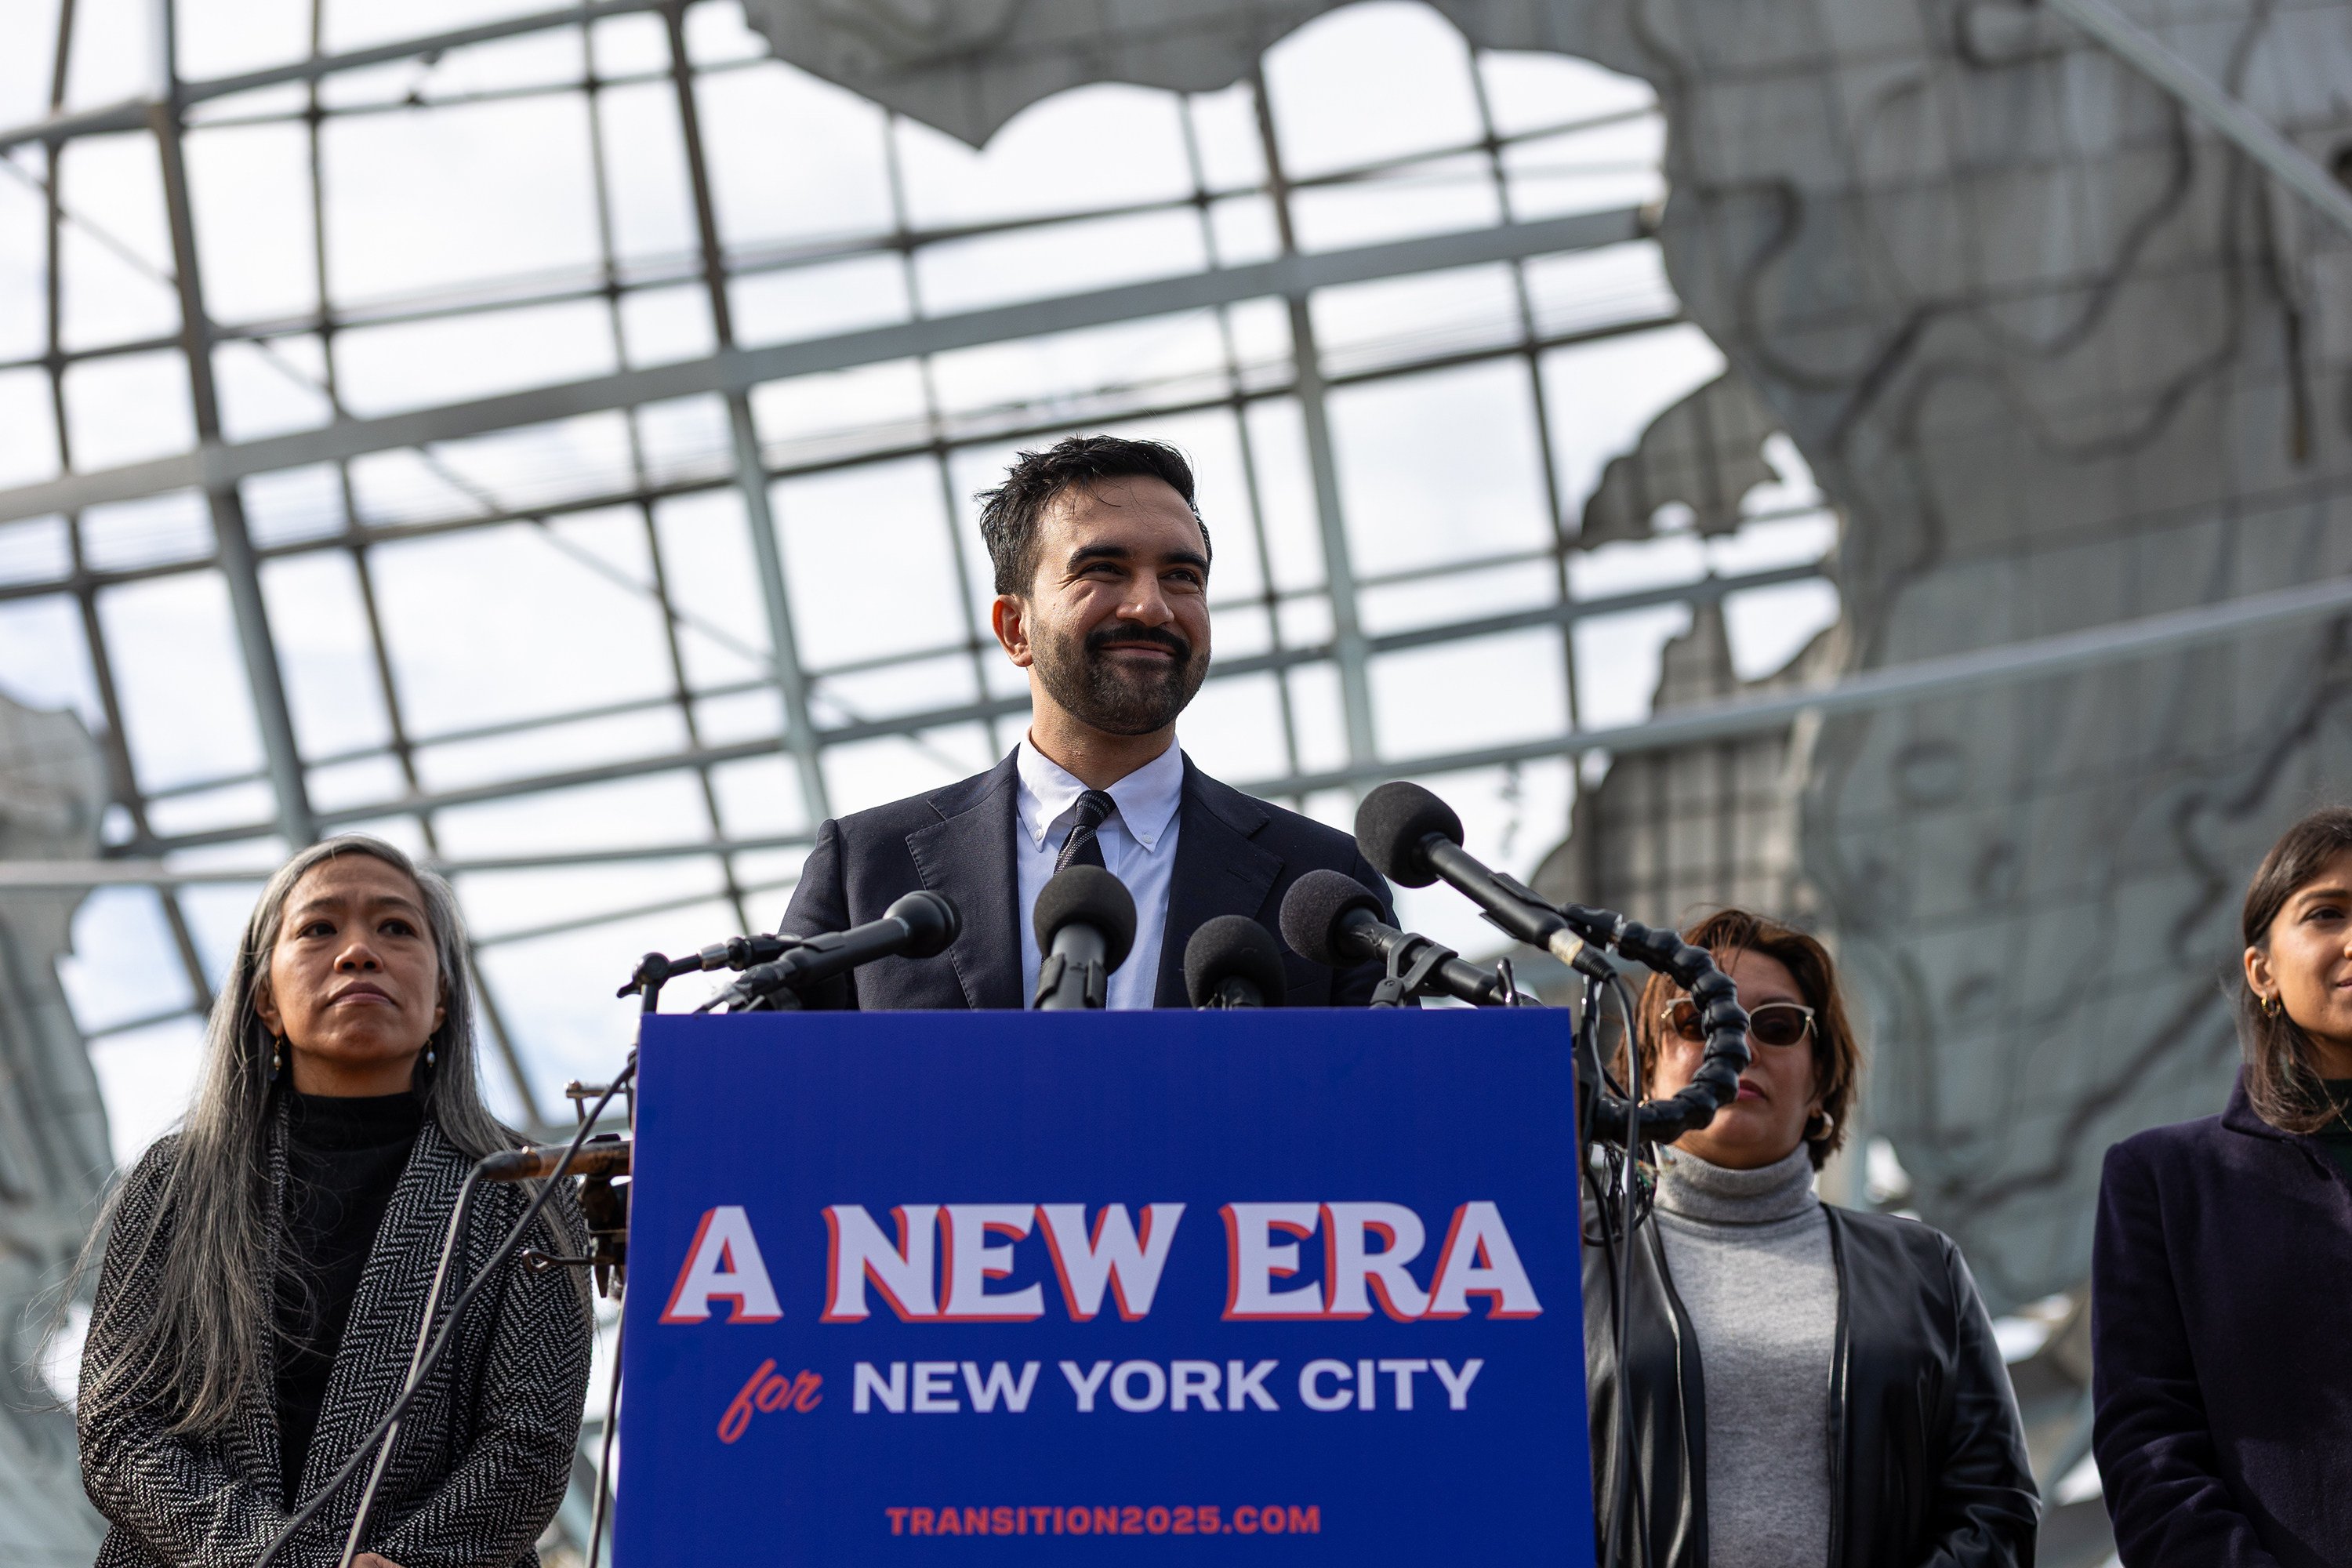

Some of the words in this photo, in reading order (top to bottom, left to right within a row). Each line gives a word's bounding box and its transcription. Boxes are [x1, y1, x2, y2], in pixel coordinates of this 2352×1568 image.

[659, 1205, 784, 1324] A
[820, 1203, 1186, 1323] NEW
[1219, 1201, 1543, 1322] ERA
[717, 1359, 823, 1443] for
[853, 1362, 1040, 1414] NEW
[1059, 1360, 1279, 1412] YORK
[1299, 1359, 1484, 1411] CITY
[886, 1506, 1321, 1536] TRANSITION2025.COM
